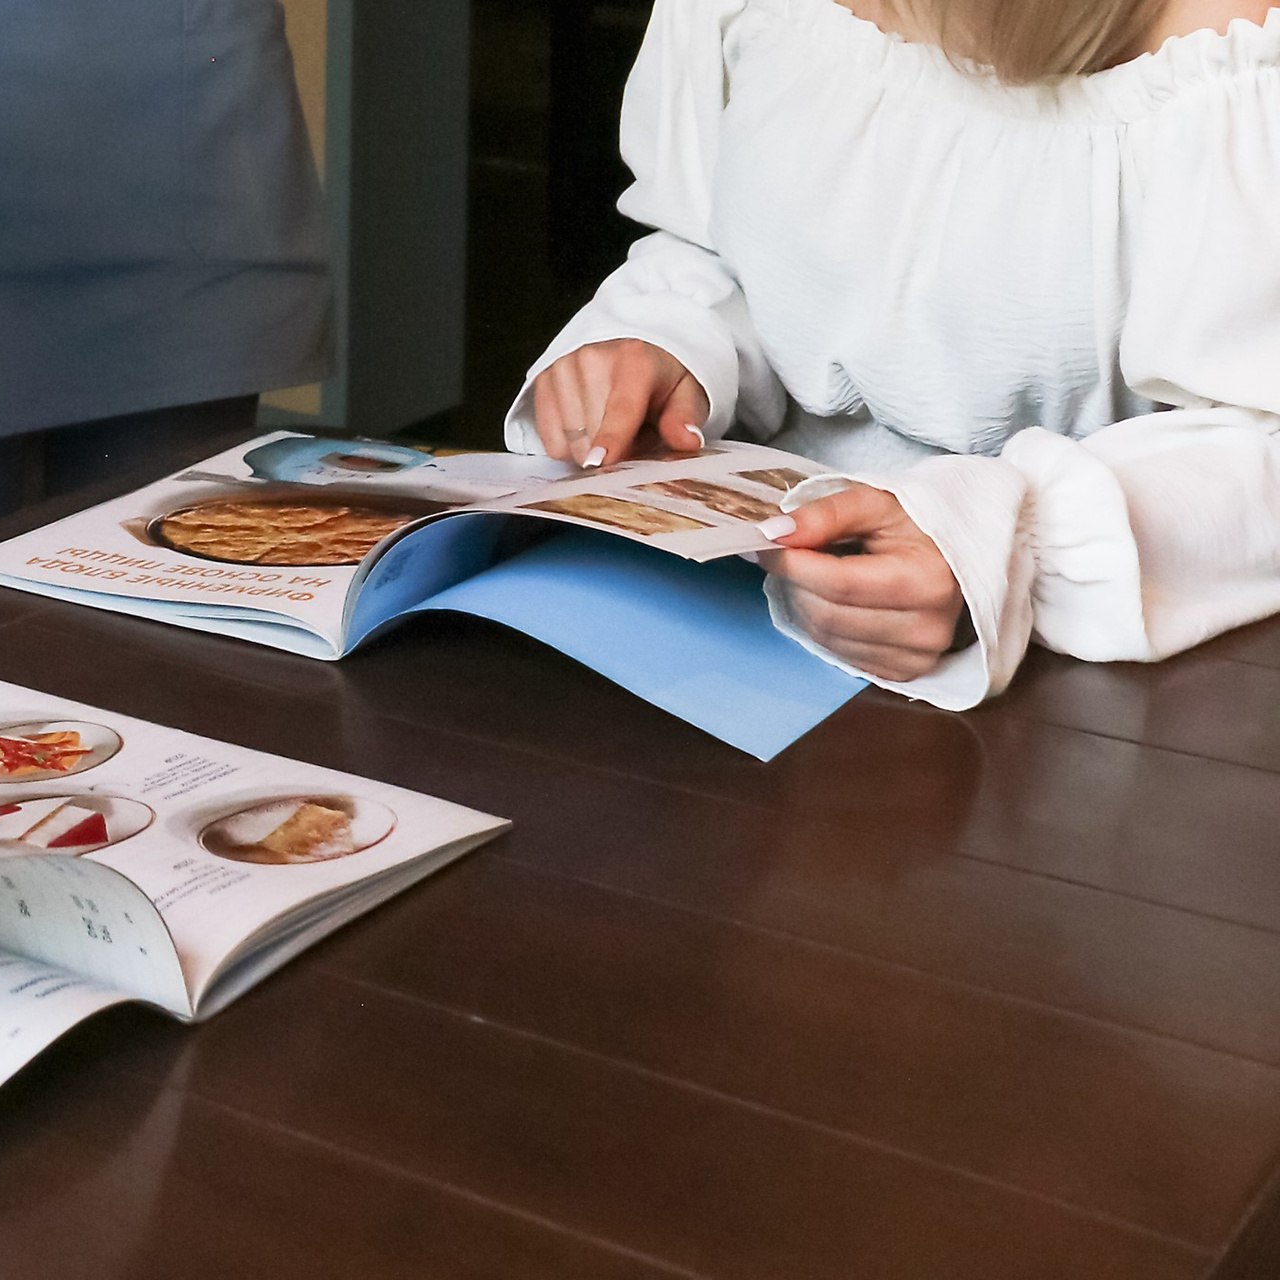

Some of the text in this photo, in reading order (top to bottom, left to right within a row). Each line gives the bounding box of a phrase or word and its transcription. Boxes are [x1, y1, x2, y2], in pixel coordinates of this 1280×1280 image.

[23, 555, 315, 602] ФИРМЕННЫЕ БЛЮДА
[56, 546, 332, 589] НА ОСНОВЕ ПИЦЦЫ
